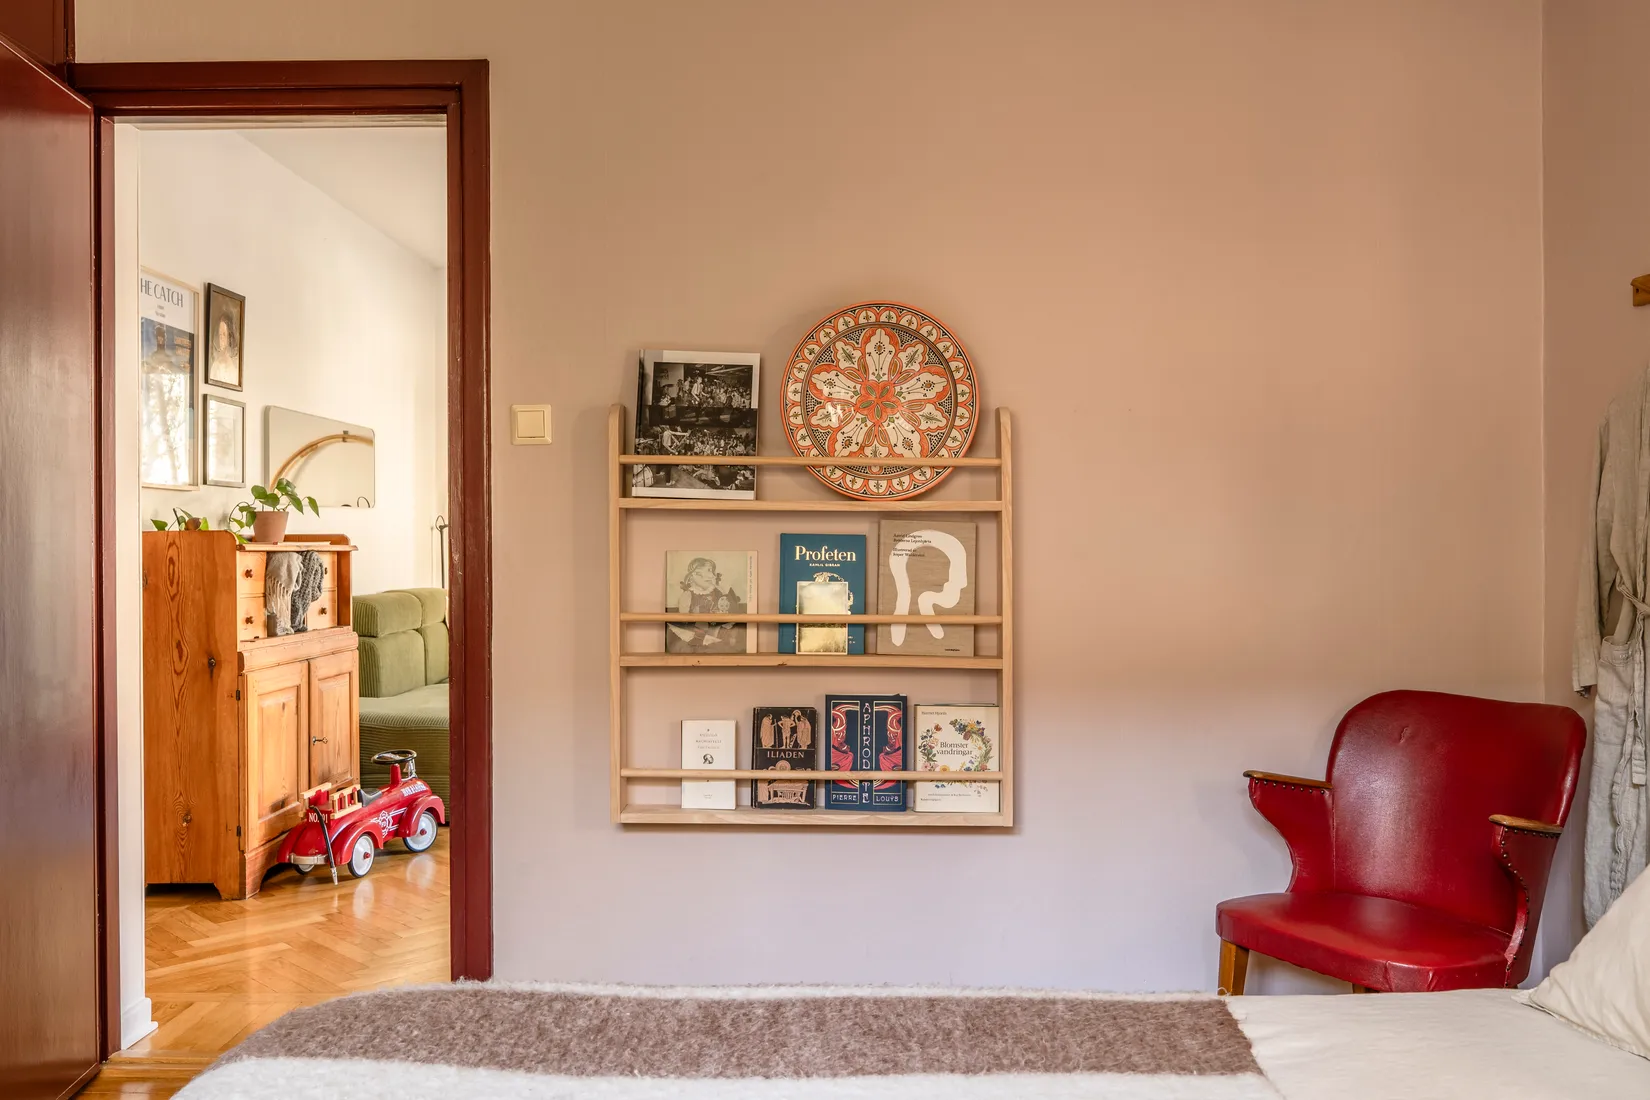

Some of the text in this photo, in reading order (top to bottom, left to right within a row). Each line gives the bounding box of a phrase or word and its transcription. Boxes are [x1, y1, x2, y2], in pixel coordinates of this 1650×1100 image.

[140, 278, 183, 307] HE CATCH
[794, 545, 857, 562] Profeten
[940, 741, 968, 749] Blomster
[767, 750, 805, 759] ILIADEN
[862, 702, 872, 804] APHRODTE
[936, 748, 973, 756] vandringar
